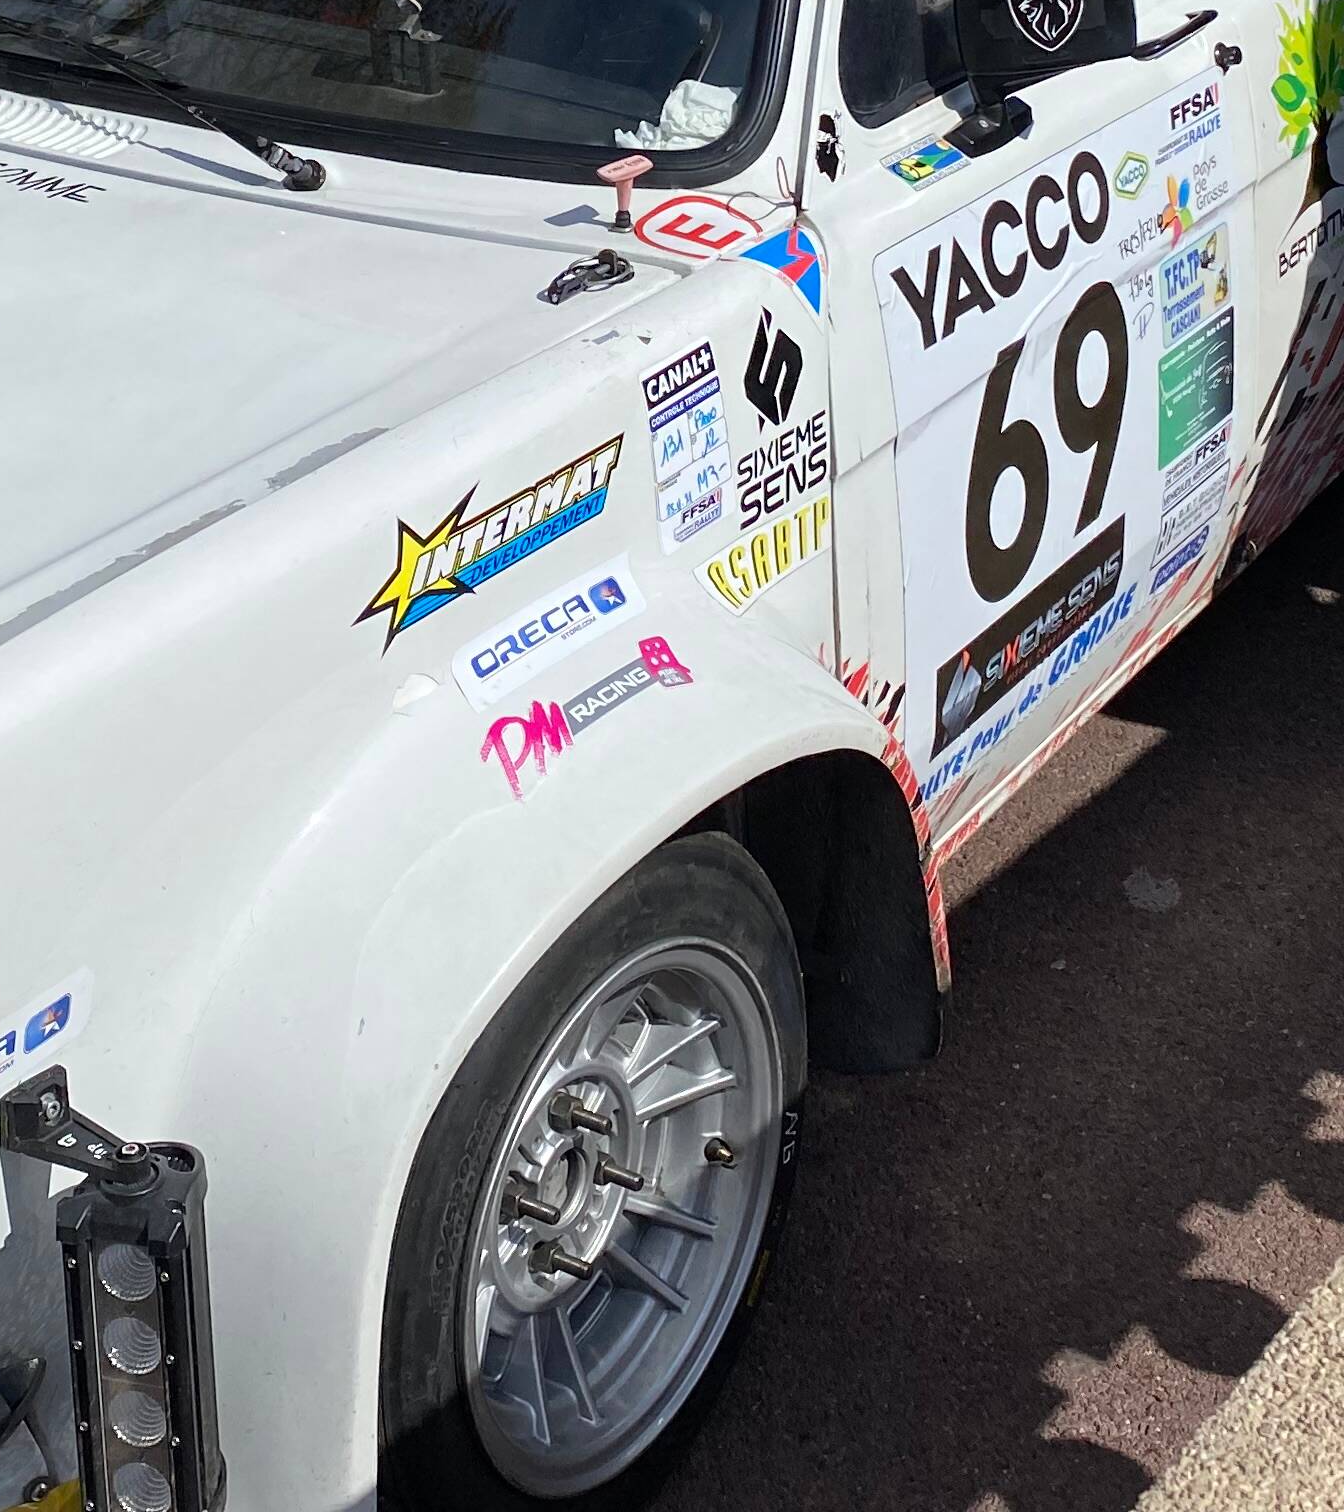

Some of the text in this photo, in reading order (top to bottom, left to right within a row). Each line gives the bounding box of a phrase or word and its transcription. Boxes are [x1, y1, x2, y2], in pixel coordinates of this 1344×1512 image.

[1169, 86, 1215, 130] FFSA
[1188, 113, 1222, 147] RALLYE
[1118, 163, 1145, 189] YACCO
[1194, 176, 1207, 195] de
[890, 151, 1109, 350] YACCO
[1164, 248, 1200, 301] T.FC.TP
[646, 348, 712, 404] CANAL+
[649, 395, 685, 429] CONTROLE
[736, 409, 828, 490] SIXIEME
[739, 440, 828, 531] SENS
[965, 281, 1129, 604] 69
[408, 441, 619, 598] INTERMAT
[469, 496, 603, 584] DEVELOPPEMENT
[682, 492, 718, 524] FFSA
[707, 495, 830, 610] ASABTP
[470, 592, 592, 680] ORECA
[984, 596, 1066, 694] SIXIEME
[1065, 549, 1122, 620] SENS
[968, 707, 1016, 762] Pays
[1018, 682, 1044, 715] de
[1047, 582, 1139, 687] GRASSE
[479, 665, 651, 803] PM RACING
